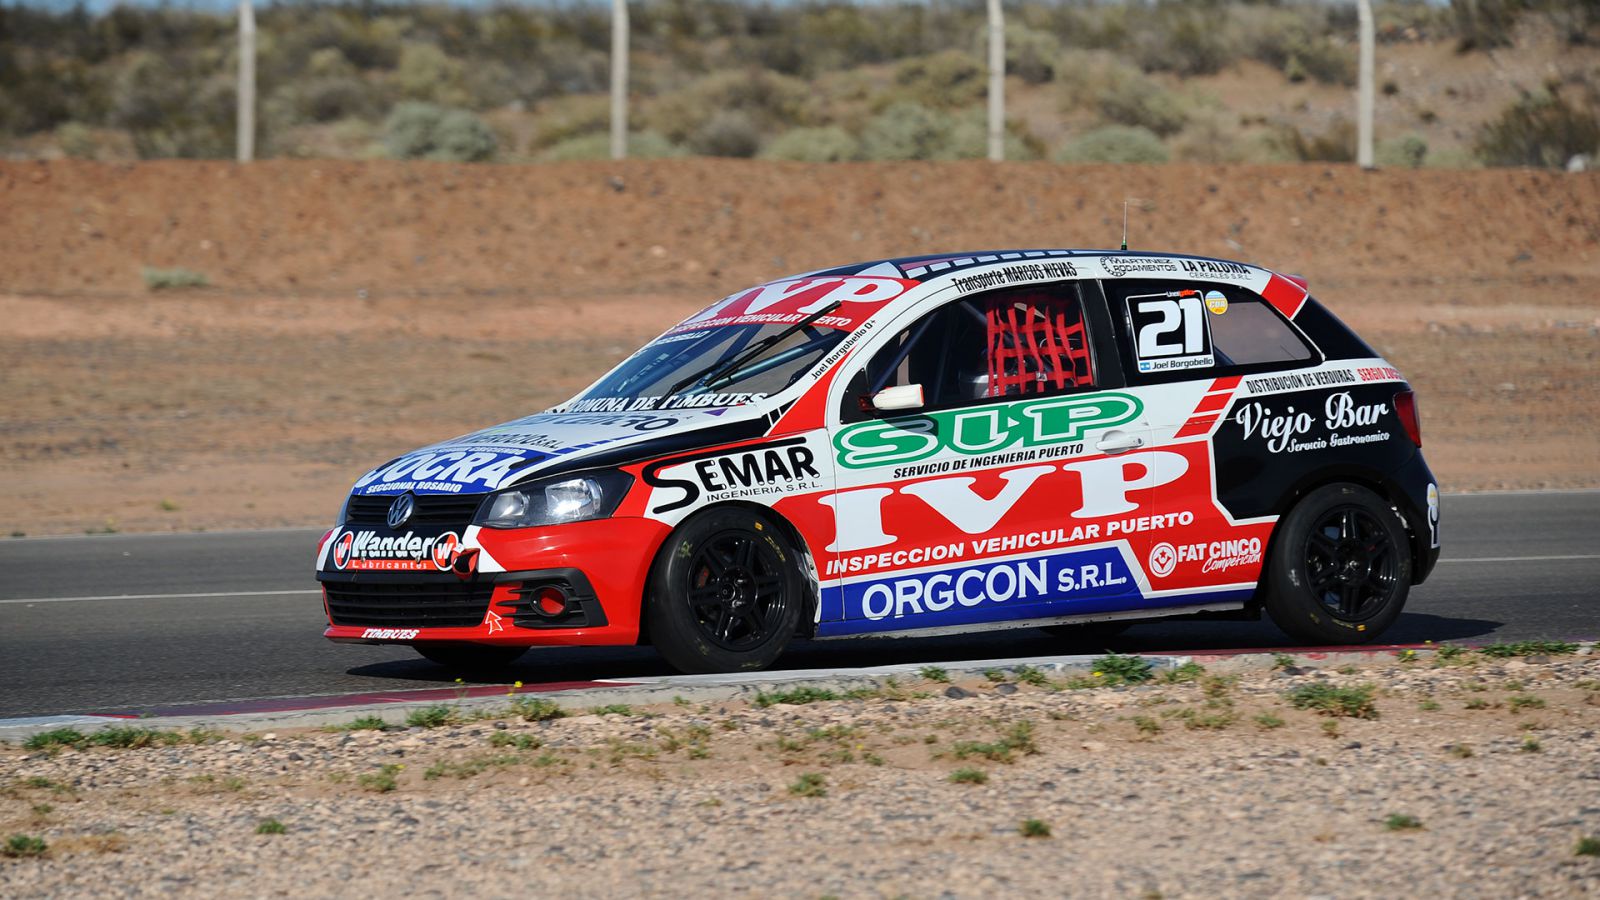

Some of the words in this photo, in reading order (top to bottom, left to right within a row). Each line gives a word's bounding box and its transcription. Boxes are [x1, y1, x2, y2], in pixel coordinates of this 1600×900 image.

[951, 269, 1005, 294] Transporte
[1002, 264, 1046, 283] MARCOS
[1041, 261, 1078, 280] NIEVAS
[1113, 264, 1177, 273] RODAMIENTOS
[1179, 260, 1197, 271] LA
[1196, 260, 1252, 274] PALOMA
[733, 311, 802, 327] VEHICULAR
[1137, 298, 1204, 358] 21
[811, 362, 829, 381] Joel
[824, 328, 869, 367] Borgobello
[1152, 360, 1169, 371] Joel
[1170, 357, 1213, 370] Borgobello
[1246, 371, 1305, 394] DISTRIBUCIÓN
[1303, 373, 1316, 388] DE
[1313, 368, 1356, 386] VERDURAS
[1356, 367, 1383, 382] SERGIO
[630, 396, 656, 411] DE
[1236, 402, 1316, 453] Viejo
[1325, 391, 1389, 430] Bar
[1287, 437, 1327, 453] Servicio
[1329, 430, 1390, 448] Gastronomico
[893, 460, 950, 479] SERVICIO
[951, 458, 968, 471] DE
[969, 449, 1036, 471] INGENIERIA
[1037, 443, 1085, 460] PUERTO
[366, 480, 416, 494] SECCIONAL
[415, 481, 463, 494] ROSARIO
[641, 436, 821, 515] SEMAR
[706, 486, 782, 502] INGENIERIA
[785, 481, 824, 492] S.R.L.
[817, 450, 1190, 554] IVP
[350, 531, 437, 559] Wander
[826, 542, 966, 576] INSPECCION
[971, 523, 1101, 554] VEHICULAR
[1106, 510, 1195, 534] PUERTO
[1177, 543, 1208, 563] FAT
[1209, 537, 1262, 560] CINCO
[351, 560, 428, 570] Lubricantes
[862, 559, 1050, 621] ORGCON
[1056, 562, 1128, 593] S.R.L.
[361, 628, 421, 640] TIMBUES
